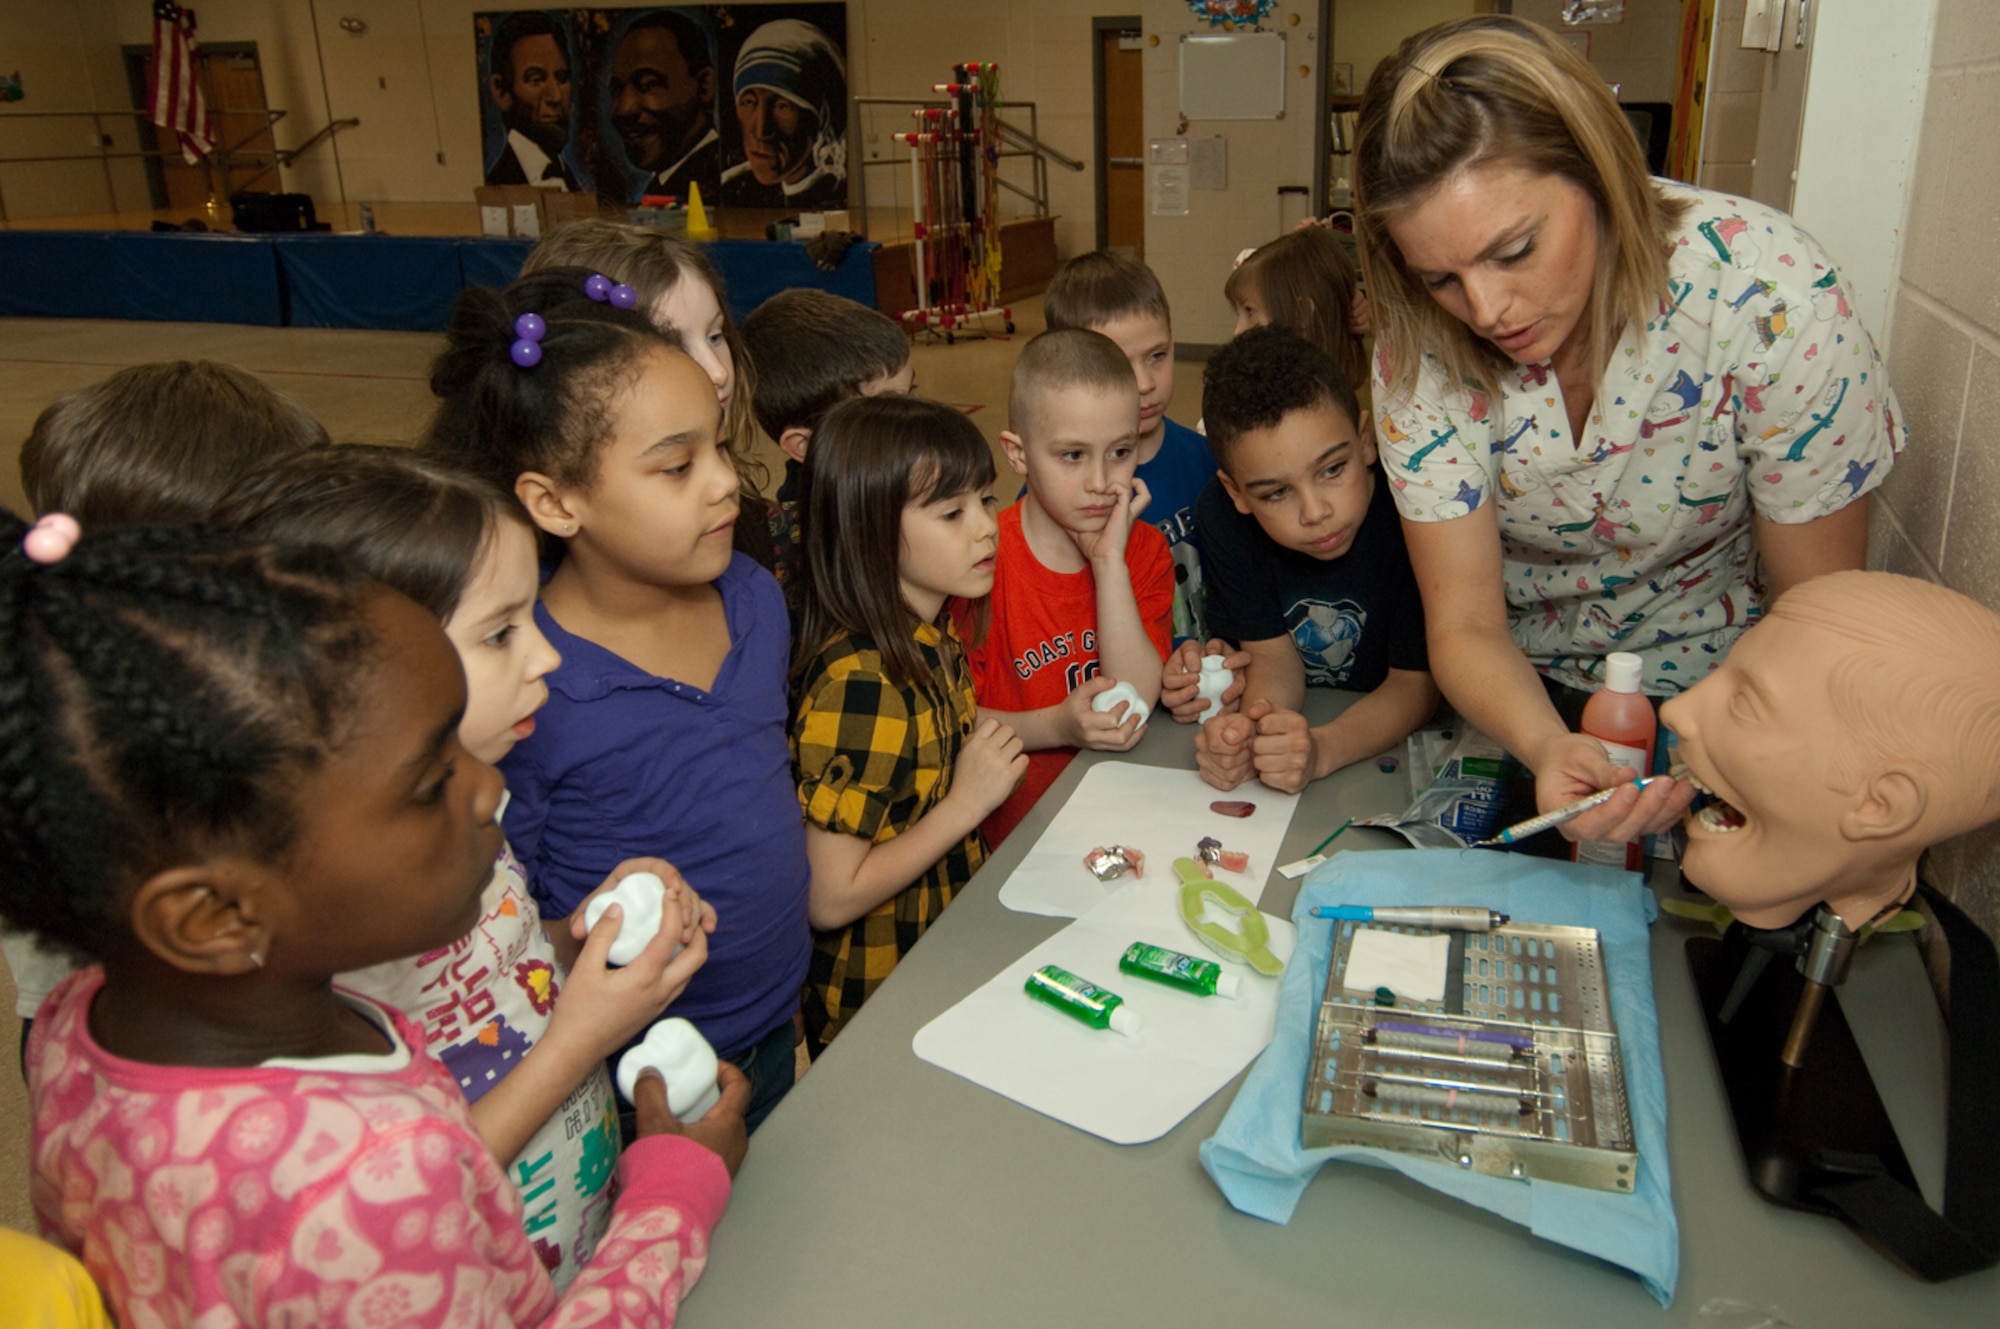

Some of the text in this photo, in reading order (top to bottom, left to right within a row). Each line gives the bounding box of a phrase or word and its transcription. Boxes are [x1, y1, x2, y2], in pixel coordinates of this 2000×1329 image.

[1014, 631, 1078, 680] COAST
[415, 945, 463, 1046] ITTY
[450, 930, 496, 1026] ELLO
